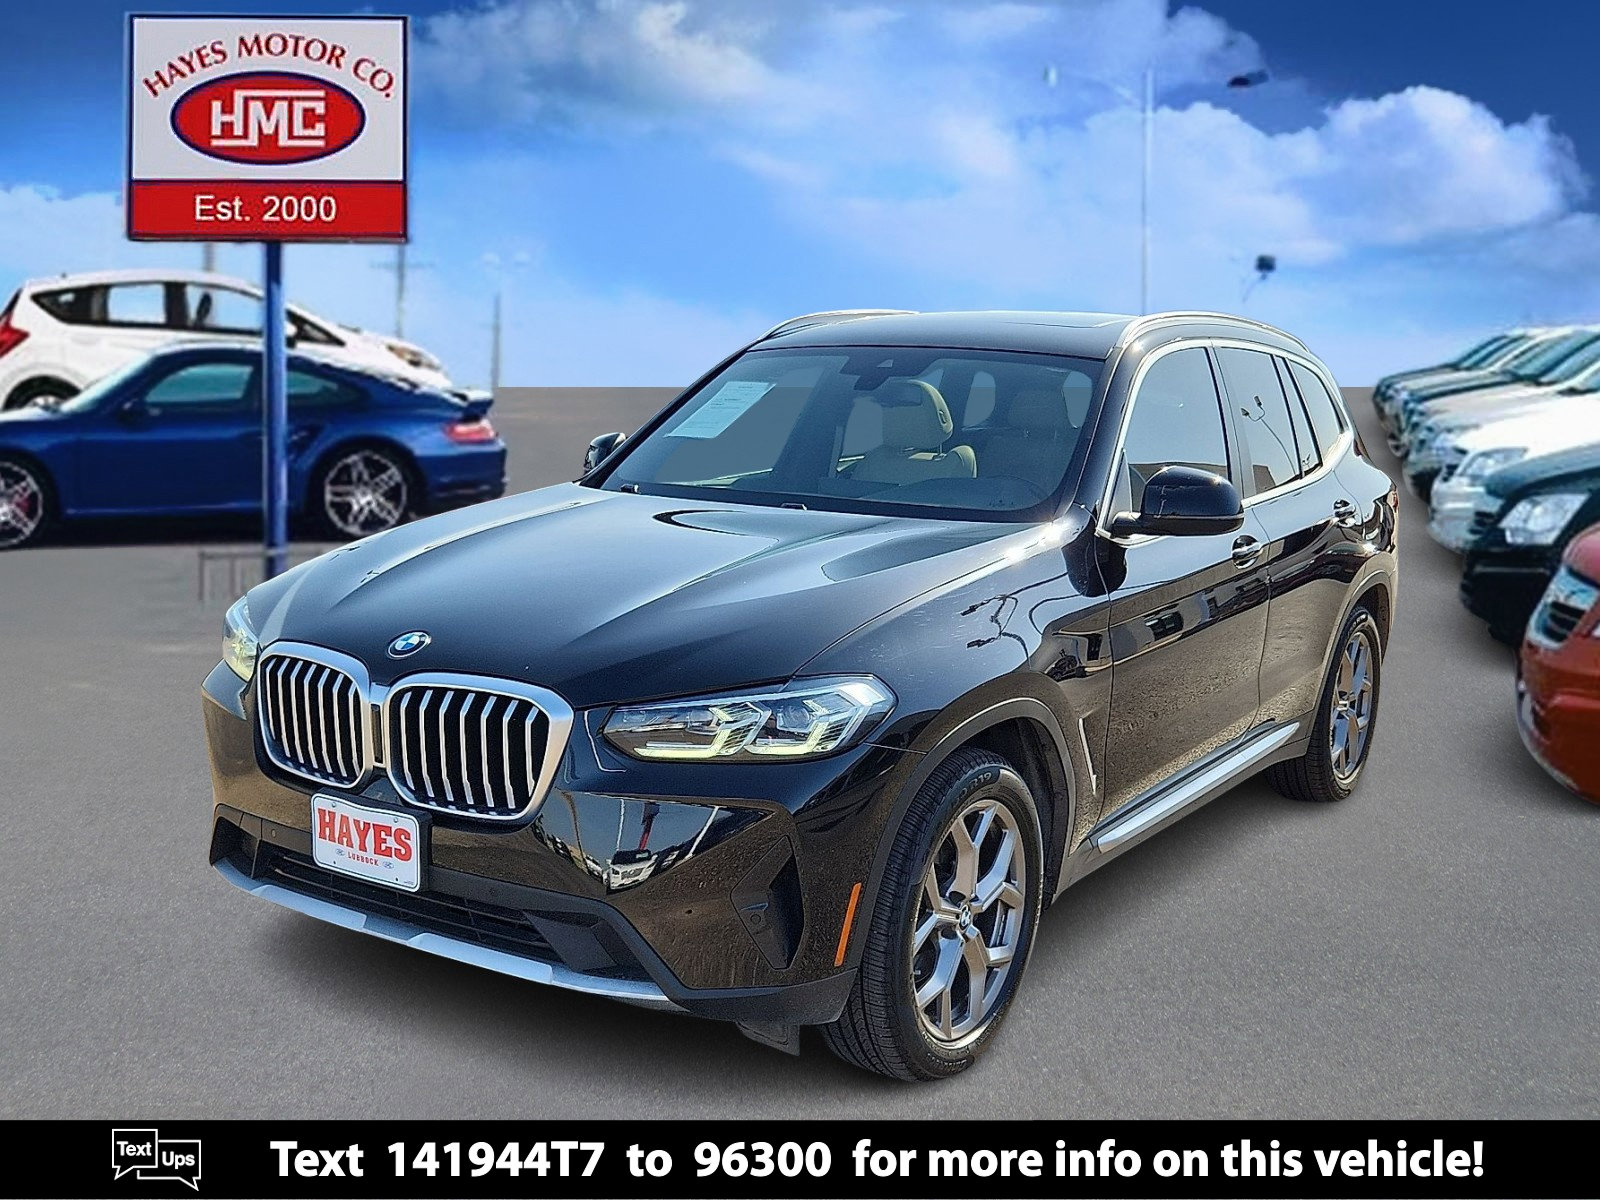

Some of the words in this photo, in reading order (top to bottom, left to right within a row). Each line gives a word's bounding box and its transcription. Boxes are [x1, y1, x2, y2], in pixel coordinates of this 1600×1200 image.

[143, 40, 228, 98] HAYES
[237, 32, 347, 70] MOTOR
[352, 57, 395, 99] CO.
[210, 88, 326, 148] HMC
[194, 193, 250, 222] Est.
[262, 194, 337, 223] 2000
[317, 807, 413, 863] HAYES
